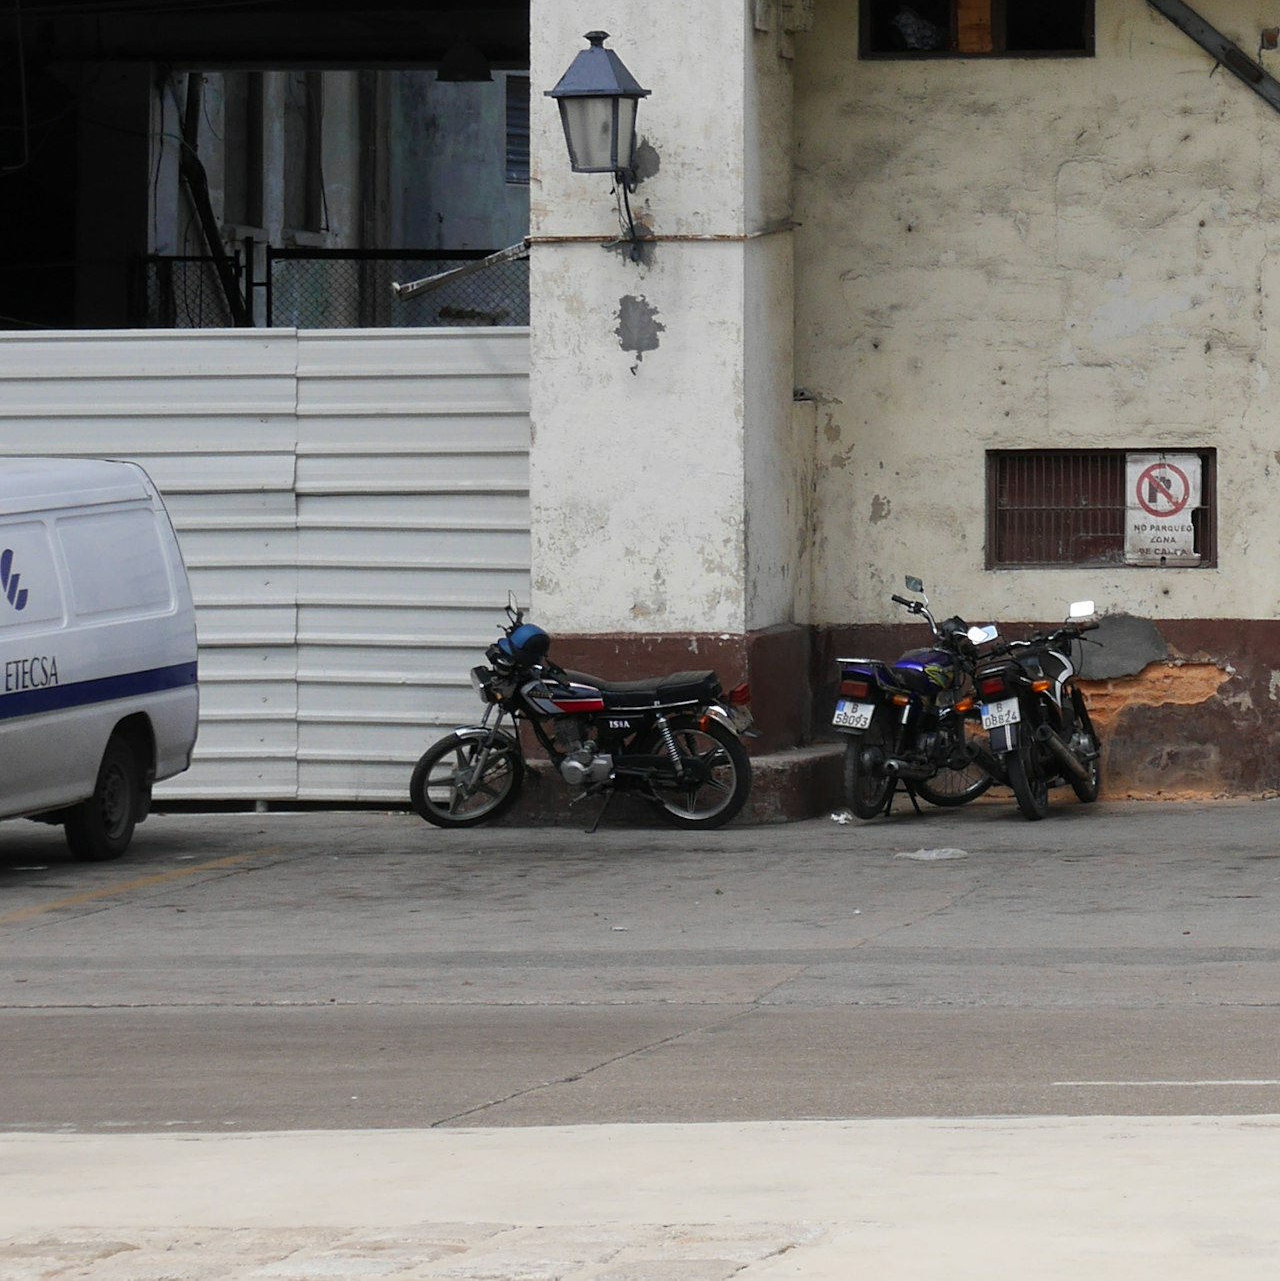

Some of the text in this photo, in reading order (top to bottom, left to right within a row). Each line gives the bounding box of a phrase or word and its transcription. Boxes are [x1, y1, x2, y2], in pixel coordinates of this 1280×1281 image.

[1134, 524, 1193, 532] NO PARQUEO
[5, 655, 59, 692] ETECSA
